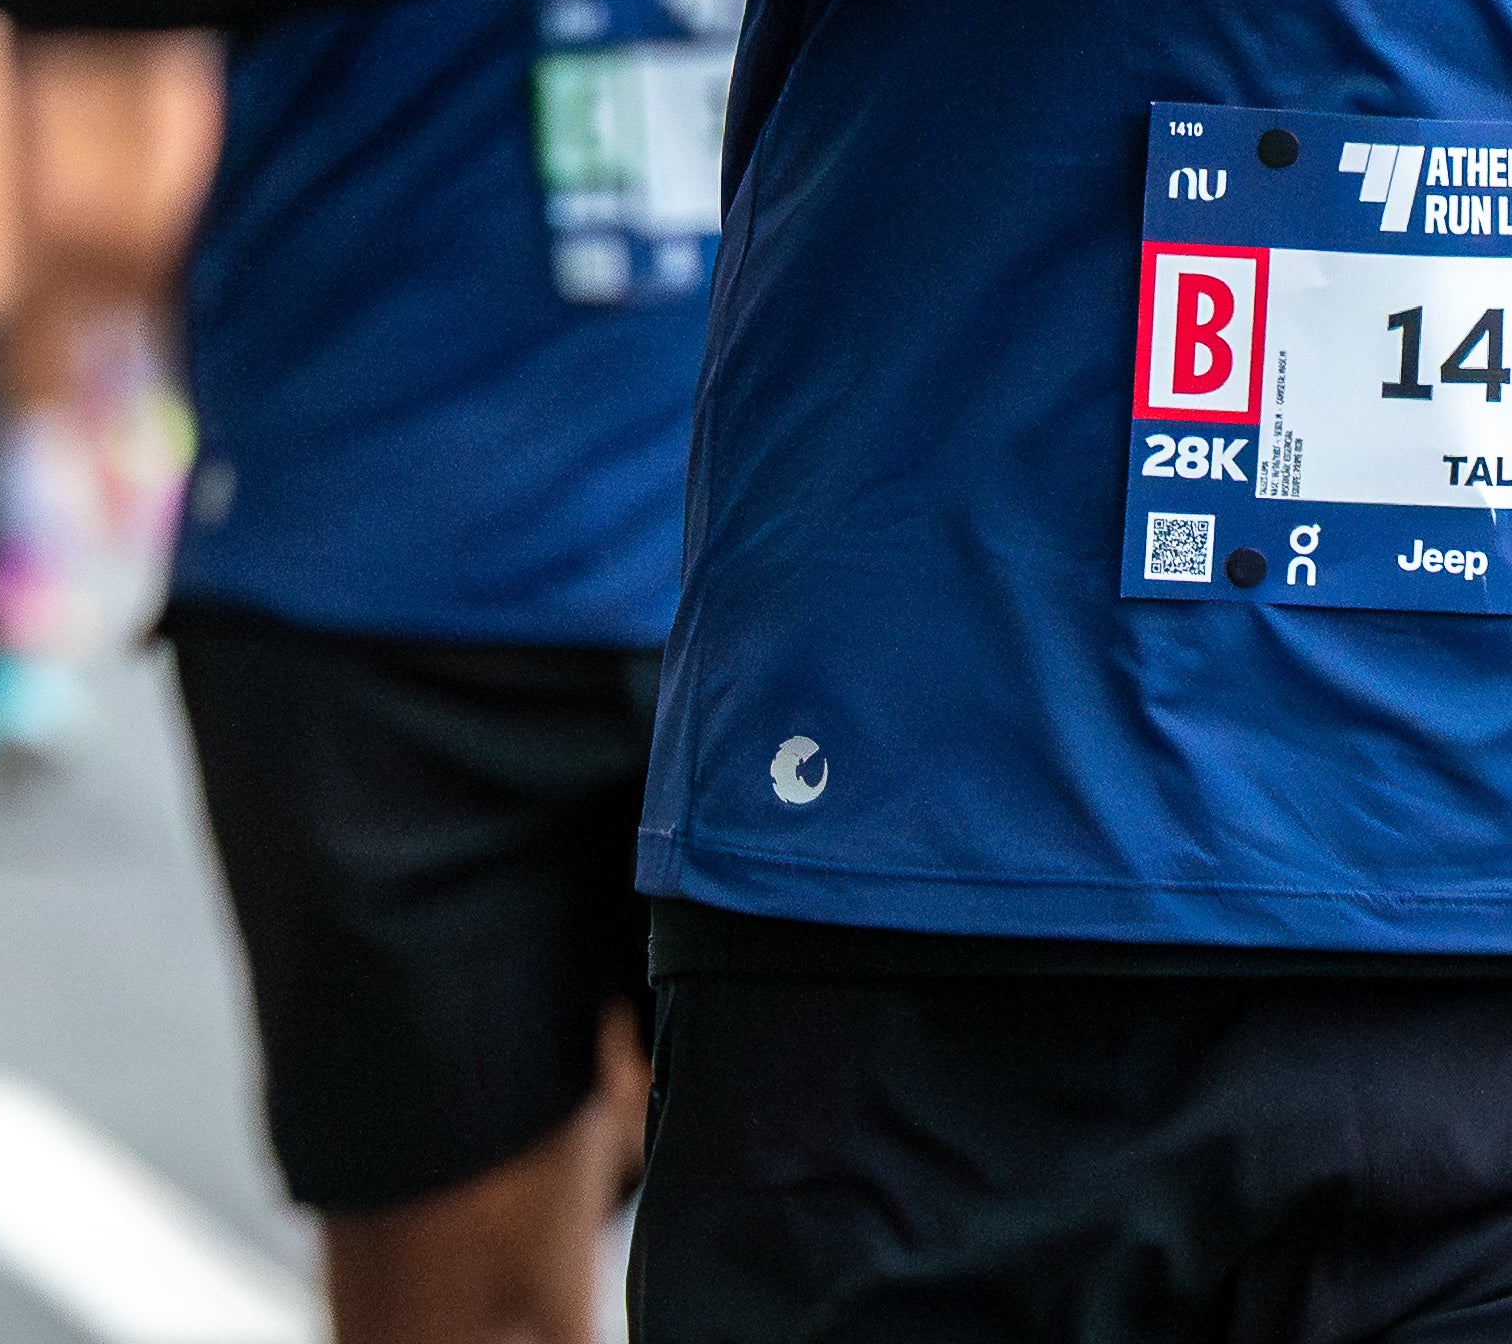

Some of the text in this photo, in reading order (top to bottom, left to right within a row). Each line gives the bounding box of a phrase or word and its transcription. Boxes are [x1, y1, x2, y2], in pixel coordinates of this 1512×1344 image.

[1169, 121, 1204, 138] 1410
[1424, 199, 1498, 236] RUN
[1172, 272, 1237, 395] B
[1142, 433, 1249, 483] 28K
[1398, 540, 1489, 581] Jeep
